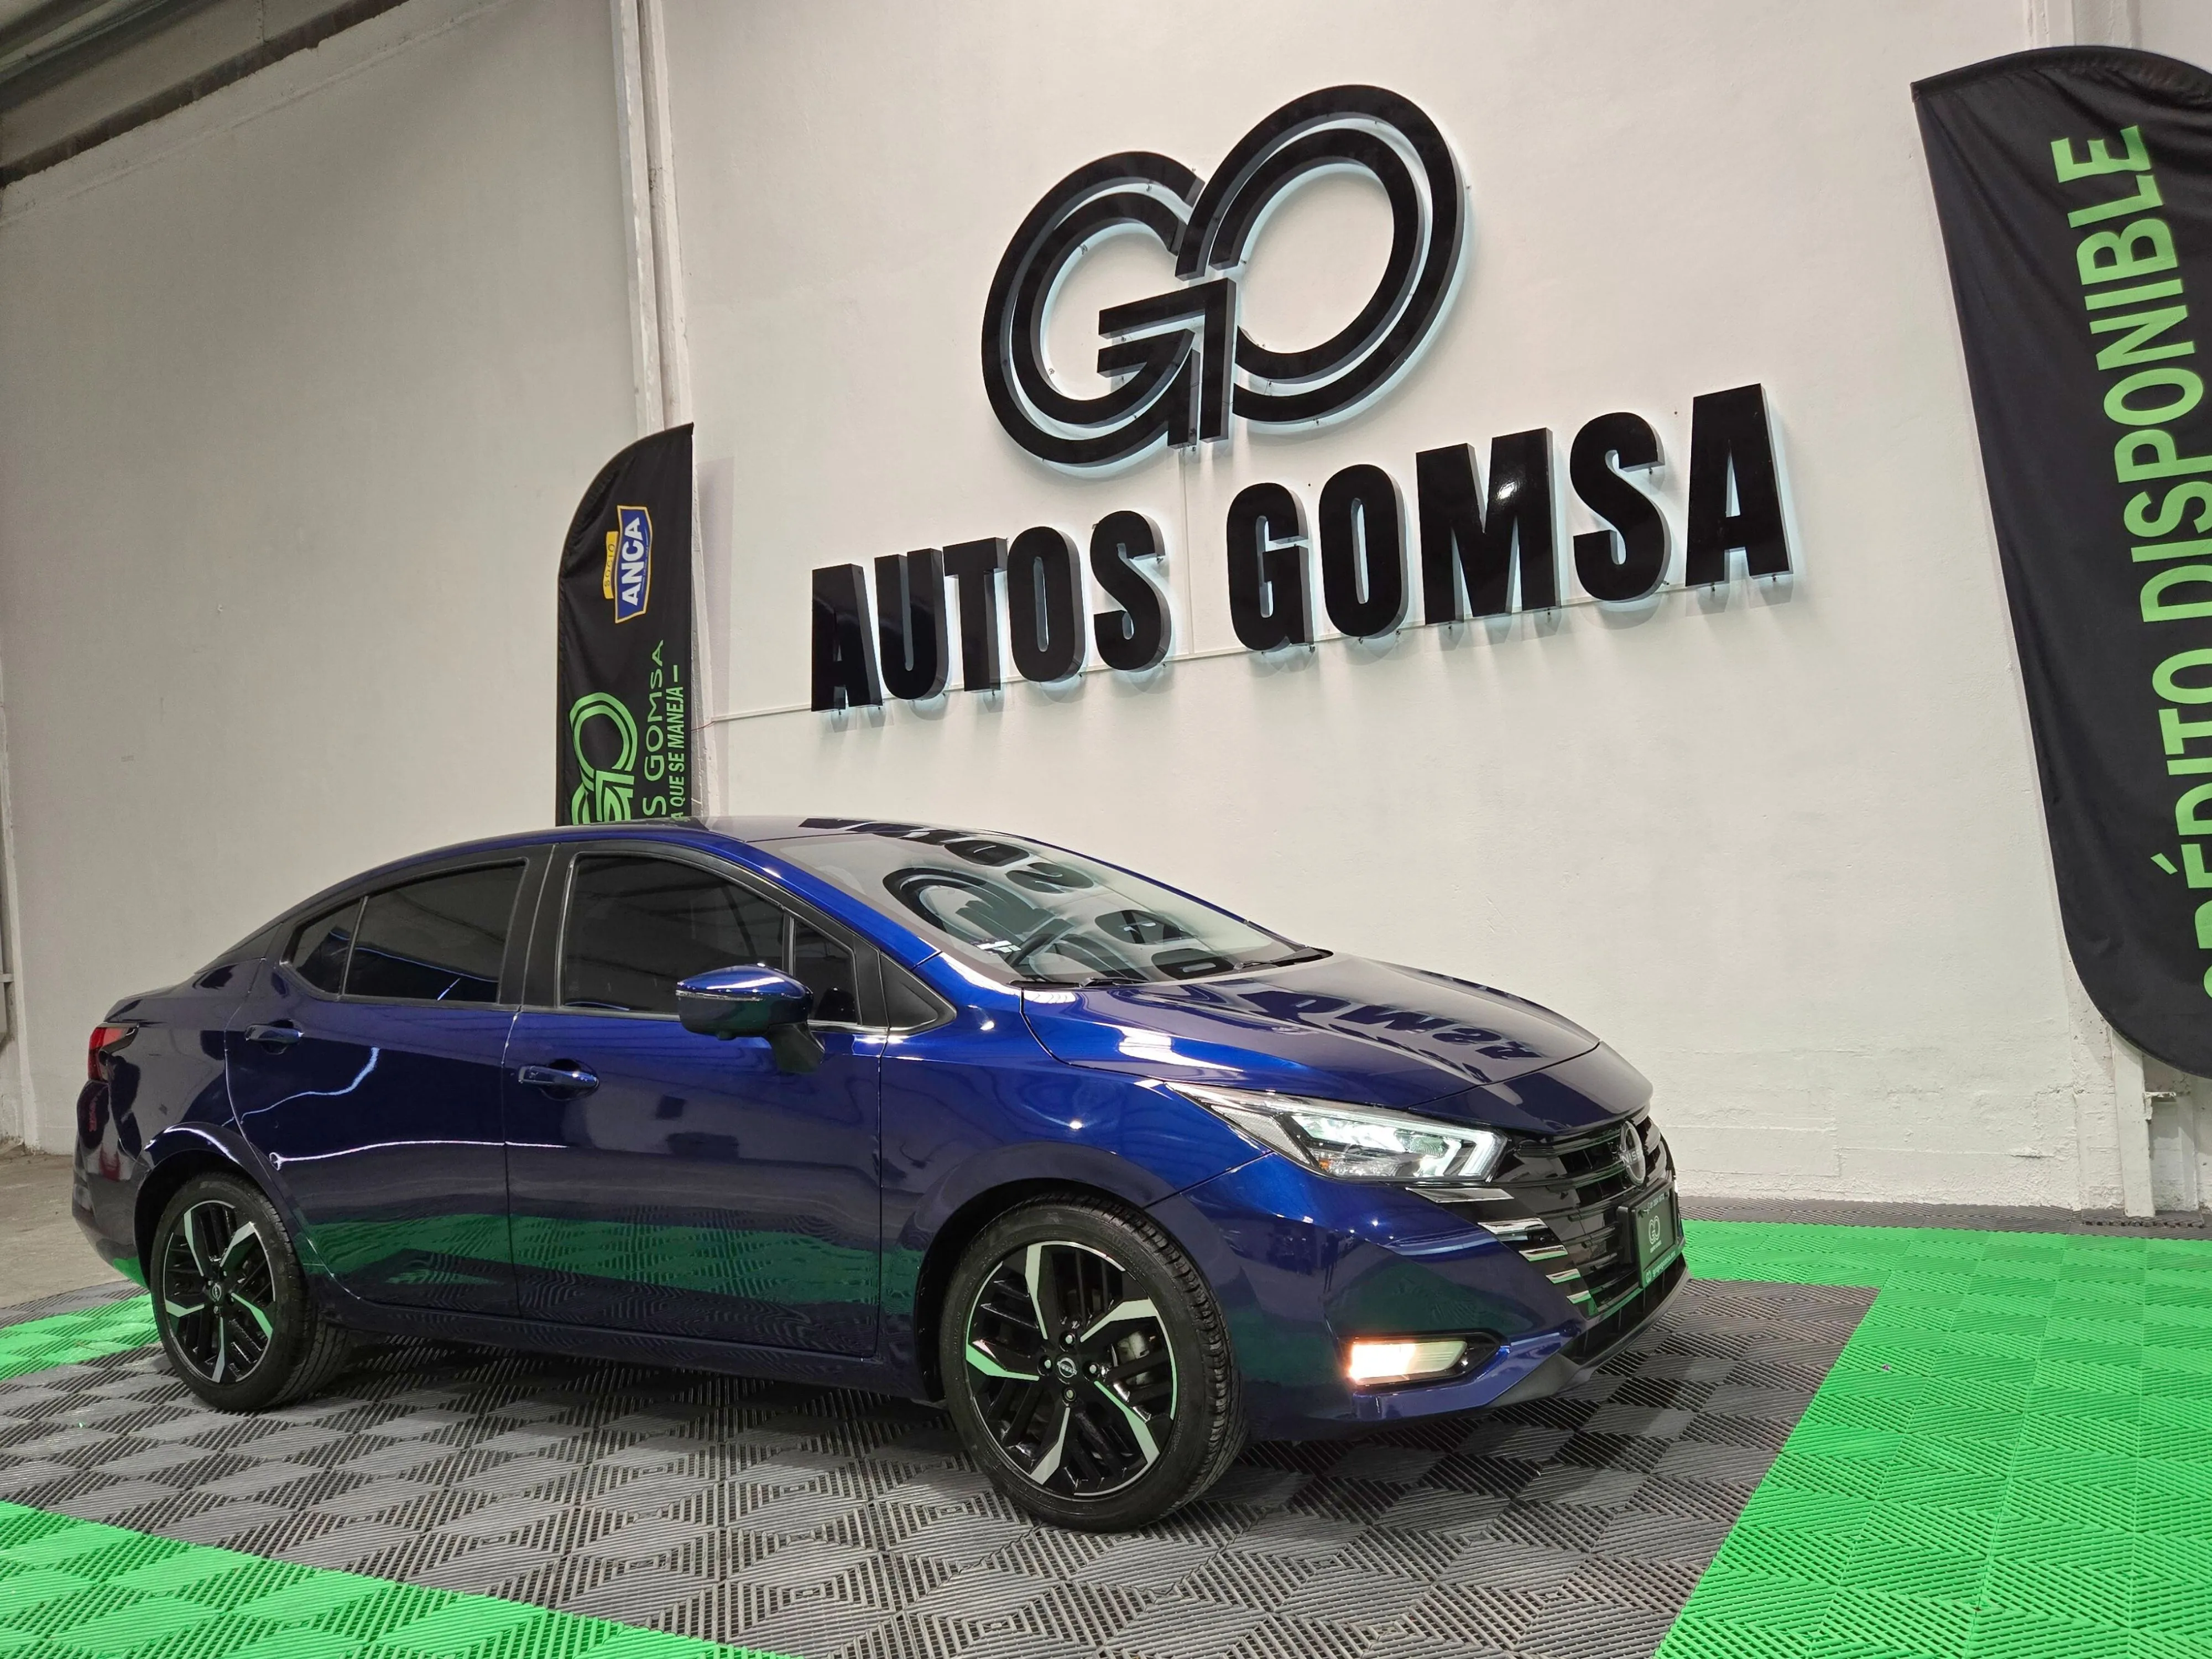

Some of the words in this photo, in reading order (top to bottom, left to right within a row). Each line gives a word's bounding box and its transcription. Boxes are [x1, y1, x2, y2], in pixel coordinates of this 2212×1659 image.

[2050, 125, 2212, 623] DISPONIBLE
[604, 544, 615, 587] SOCIO
[621, 517, 645, 606] ANCA
[811, 510, 1167, 713] AUTOS
[1224, 383, 1792, 653] GOMSA
[644, 640, 665, 781] GOMSA
[666, 687, 685, 749] MANEJA
[667, 753, 685, 773] SE
[669, 776, 685, 807] QUE
